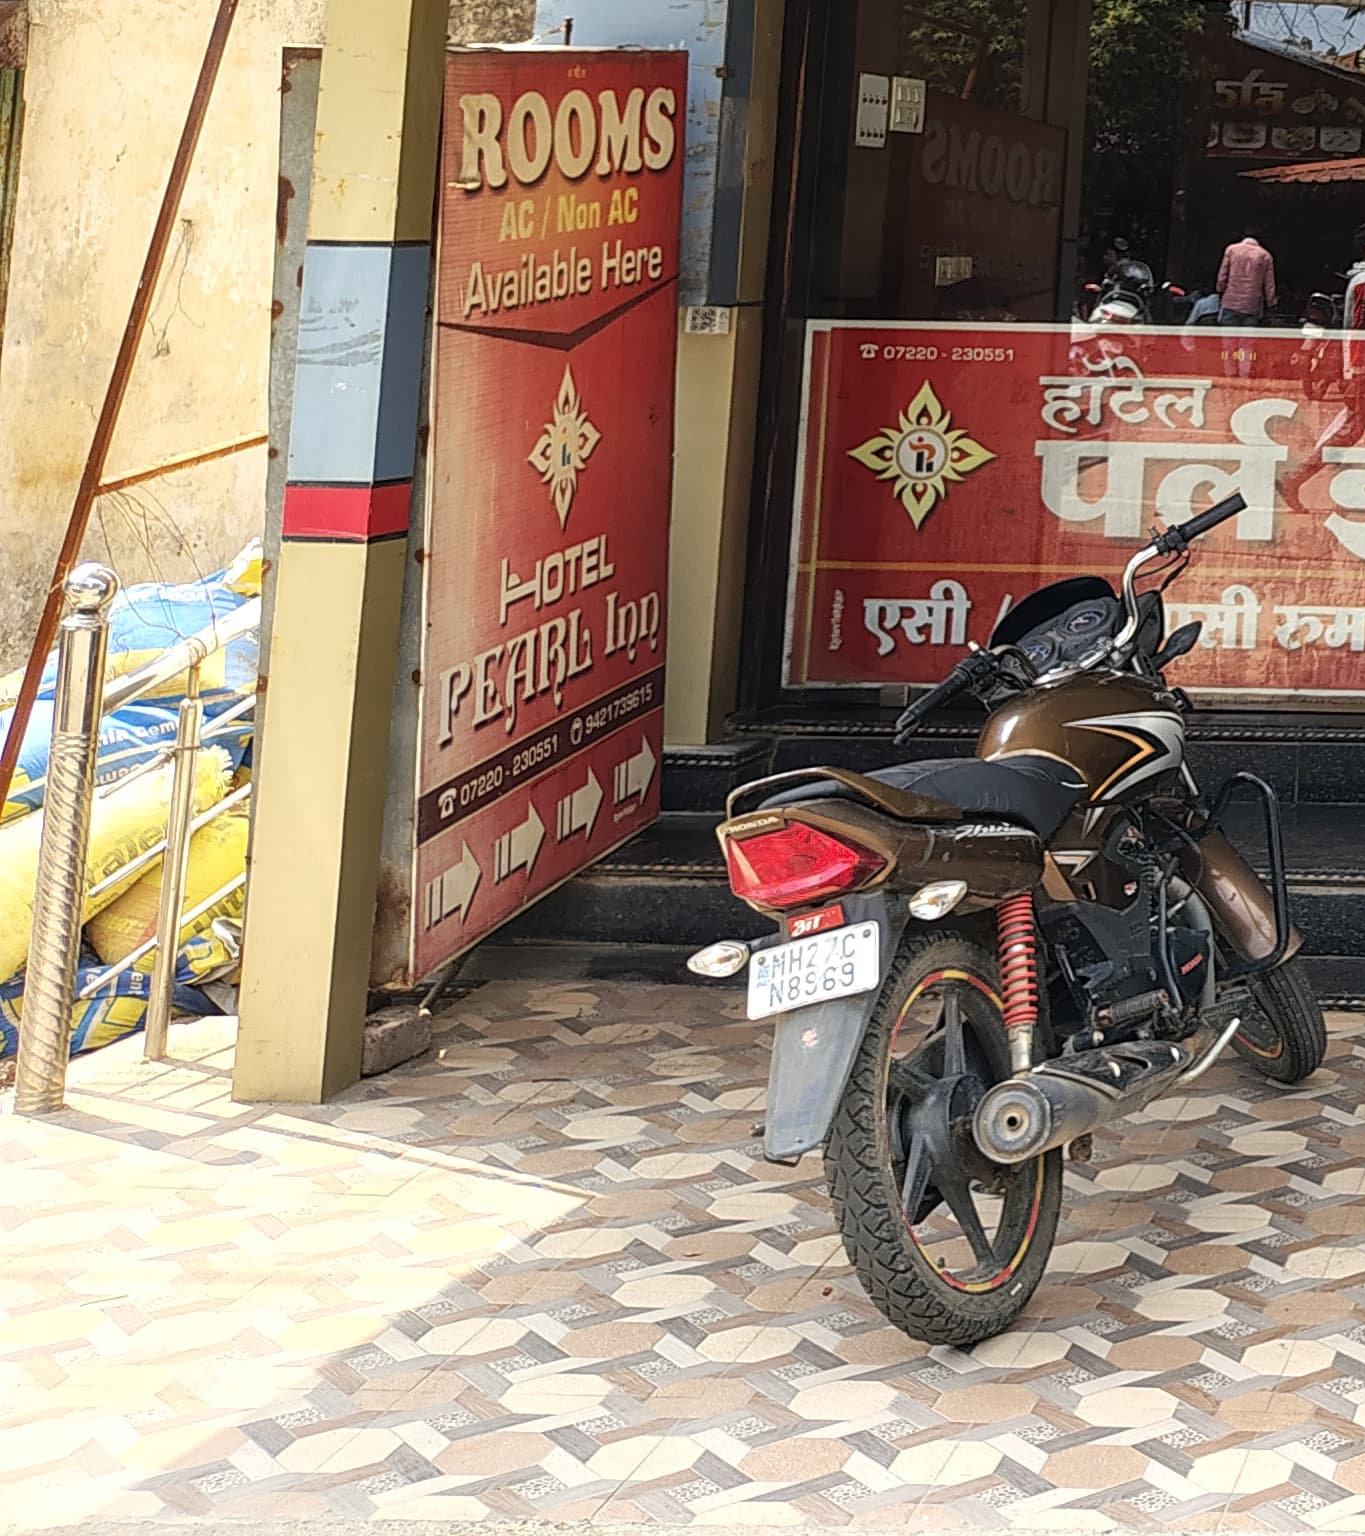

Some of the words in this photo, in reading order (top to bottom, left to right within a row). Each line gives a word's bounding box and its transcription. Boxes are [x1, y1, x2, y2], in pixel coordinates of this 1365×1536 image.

[459, 87, 676, 191] ROOMS
[500, 199, 534, 242] AC
[557, 196, 601, 234] Non
[608, 187, 639, 224] AC
[464, 253, 592, 318] Available
[602, 240, 662, 290] Here
[951, 346, 1014, 363] 230551
[1038, 355, 1212, 434] हॉटेल
[1034, 398, 1300, 542] पर्ल
[500, 533, 614, 625] HOTEL
[863, 579, 971, 656] एसी
[437, 608, 592, 748] PEARL
[605, 590, 660, 662] Inn
[728, 815, 780, 833] HONDA
